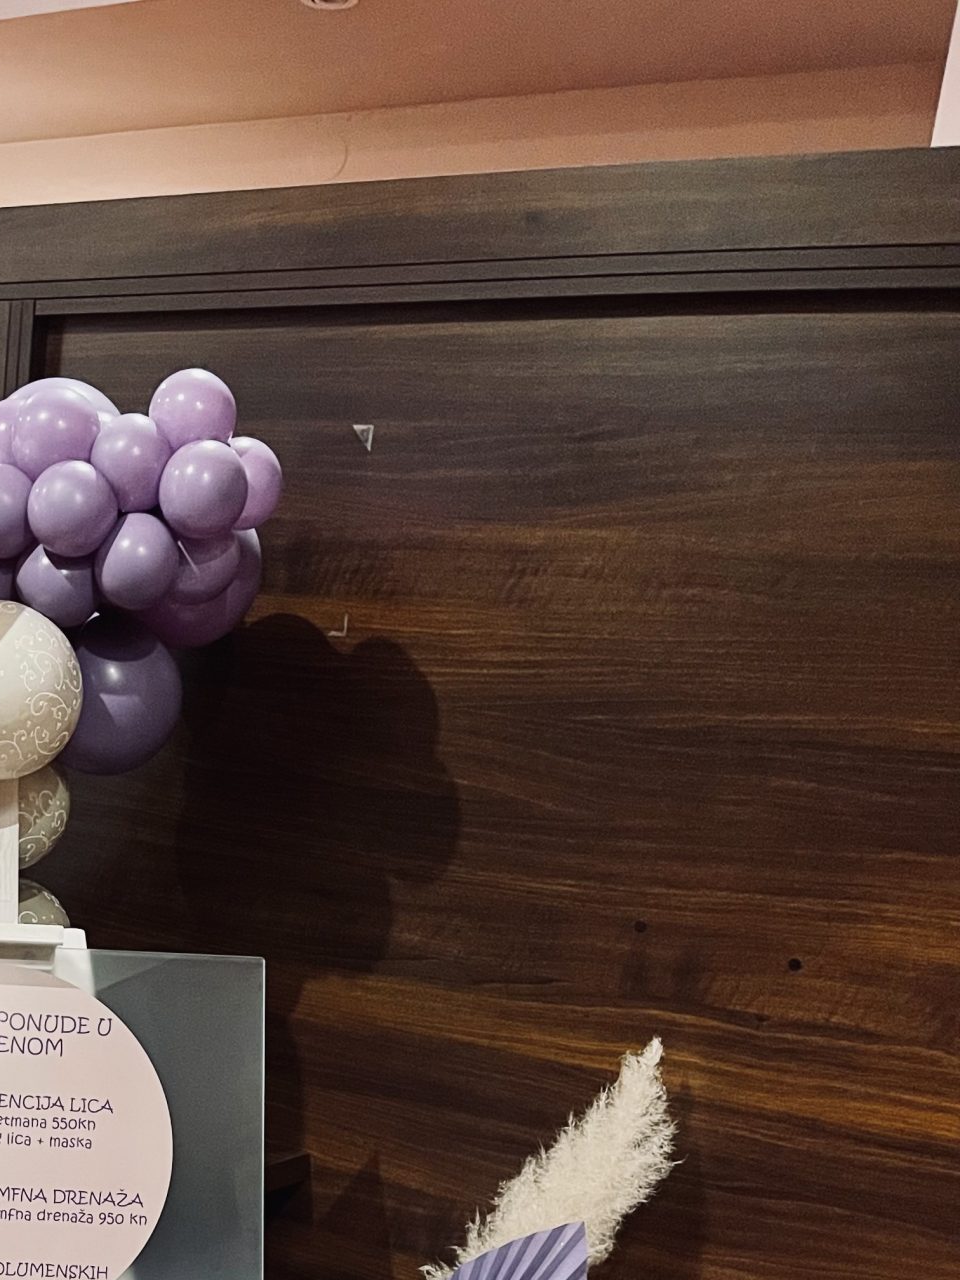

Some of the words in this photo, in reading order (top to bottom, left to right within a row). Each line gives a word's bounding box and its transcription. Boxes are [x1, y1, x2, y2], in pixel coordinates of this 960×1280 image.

[97, 1017, 112, 1036] U
[69, 1097, 114, 1114] LICA
[7, 1132, 32, 1146] lica
[50, 1135, 93, 1149] maska
[54, 1189, 144, 1208] DRENAŽA
[37, 1208, 93, 1225] drenaža
[99, 1212, 124, 1225] 950
